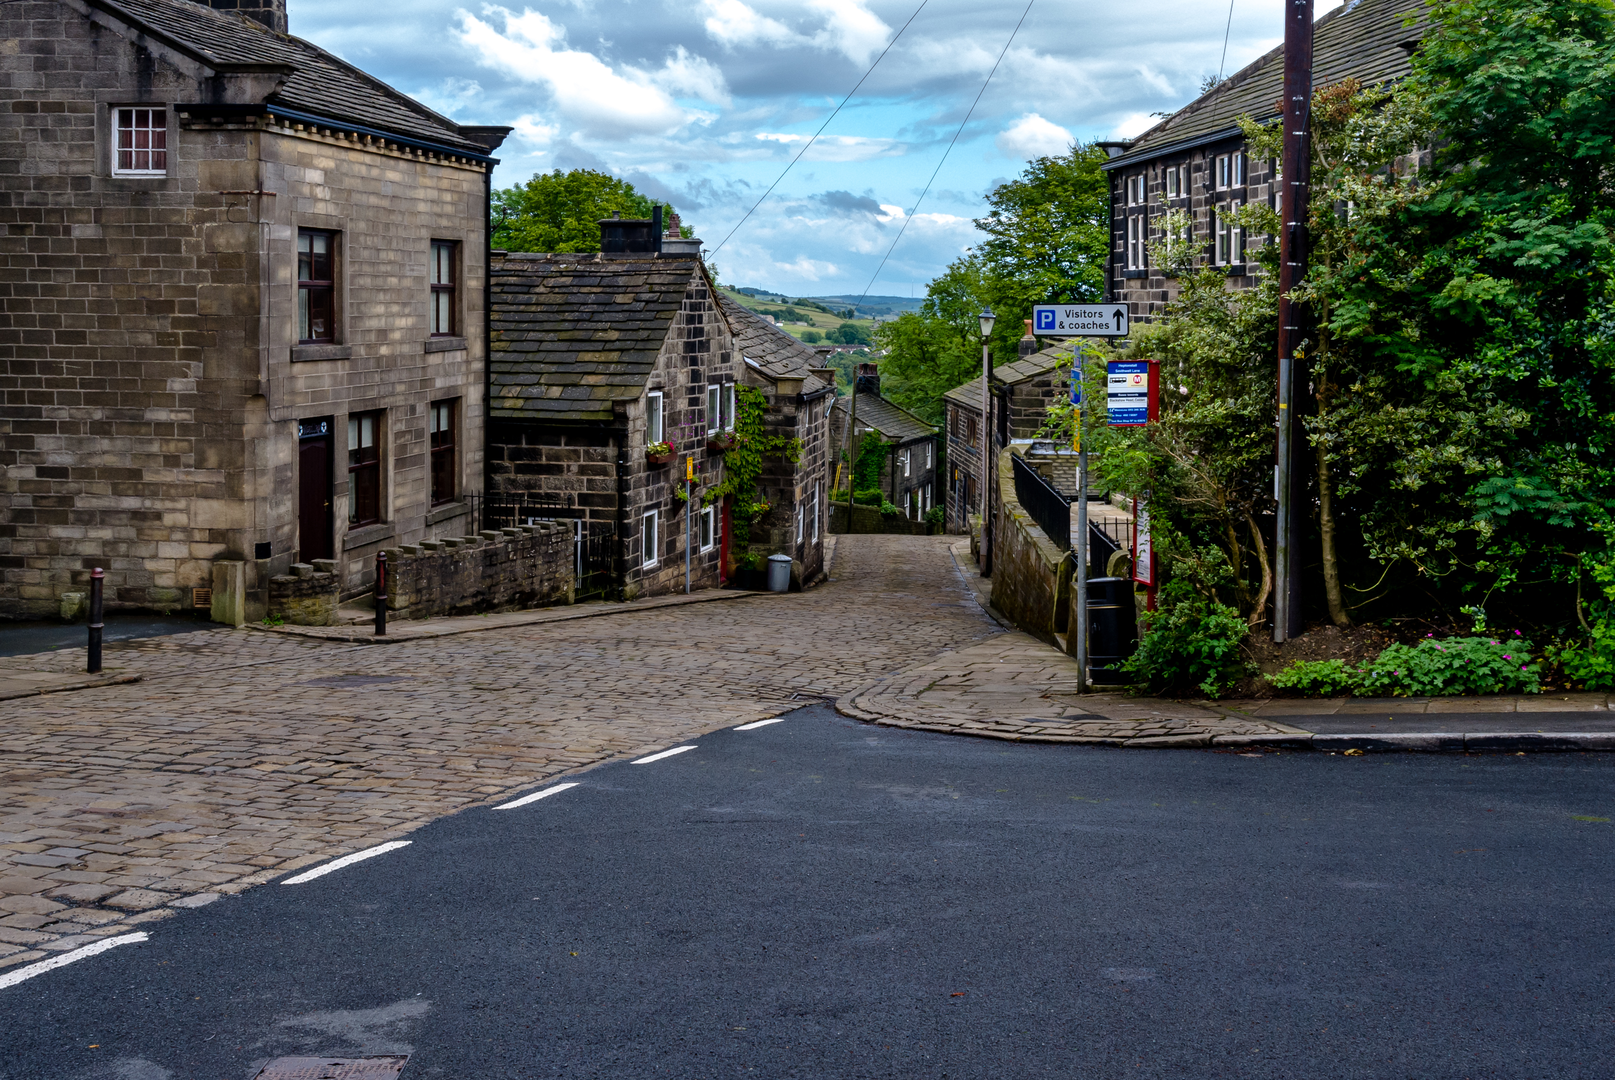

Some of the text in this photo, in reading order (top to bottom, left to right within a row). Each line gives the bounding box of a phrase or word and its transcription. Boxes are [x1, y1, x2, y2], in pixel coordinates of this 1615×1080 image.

[1064, 309, 1104, 319] Visitors
[1041, 312, 1053, 328] P
[1058, 320, 1110, 330] & coaches
